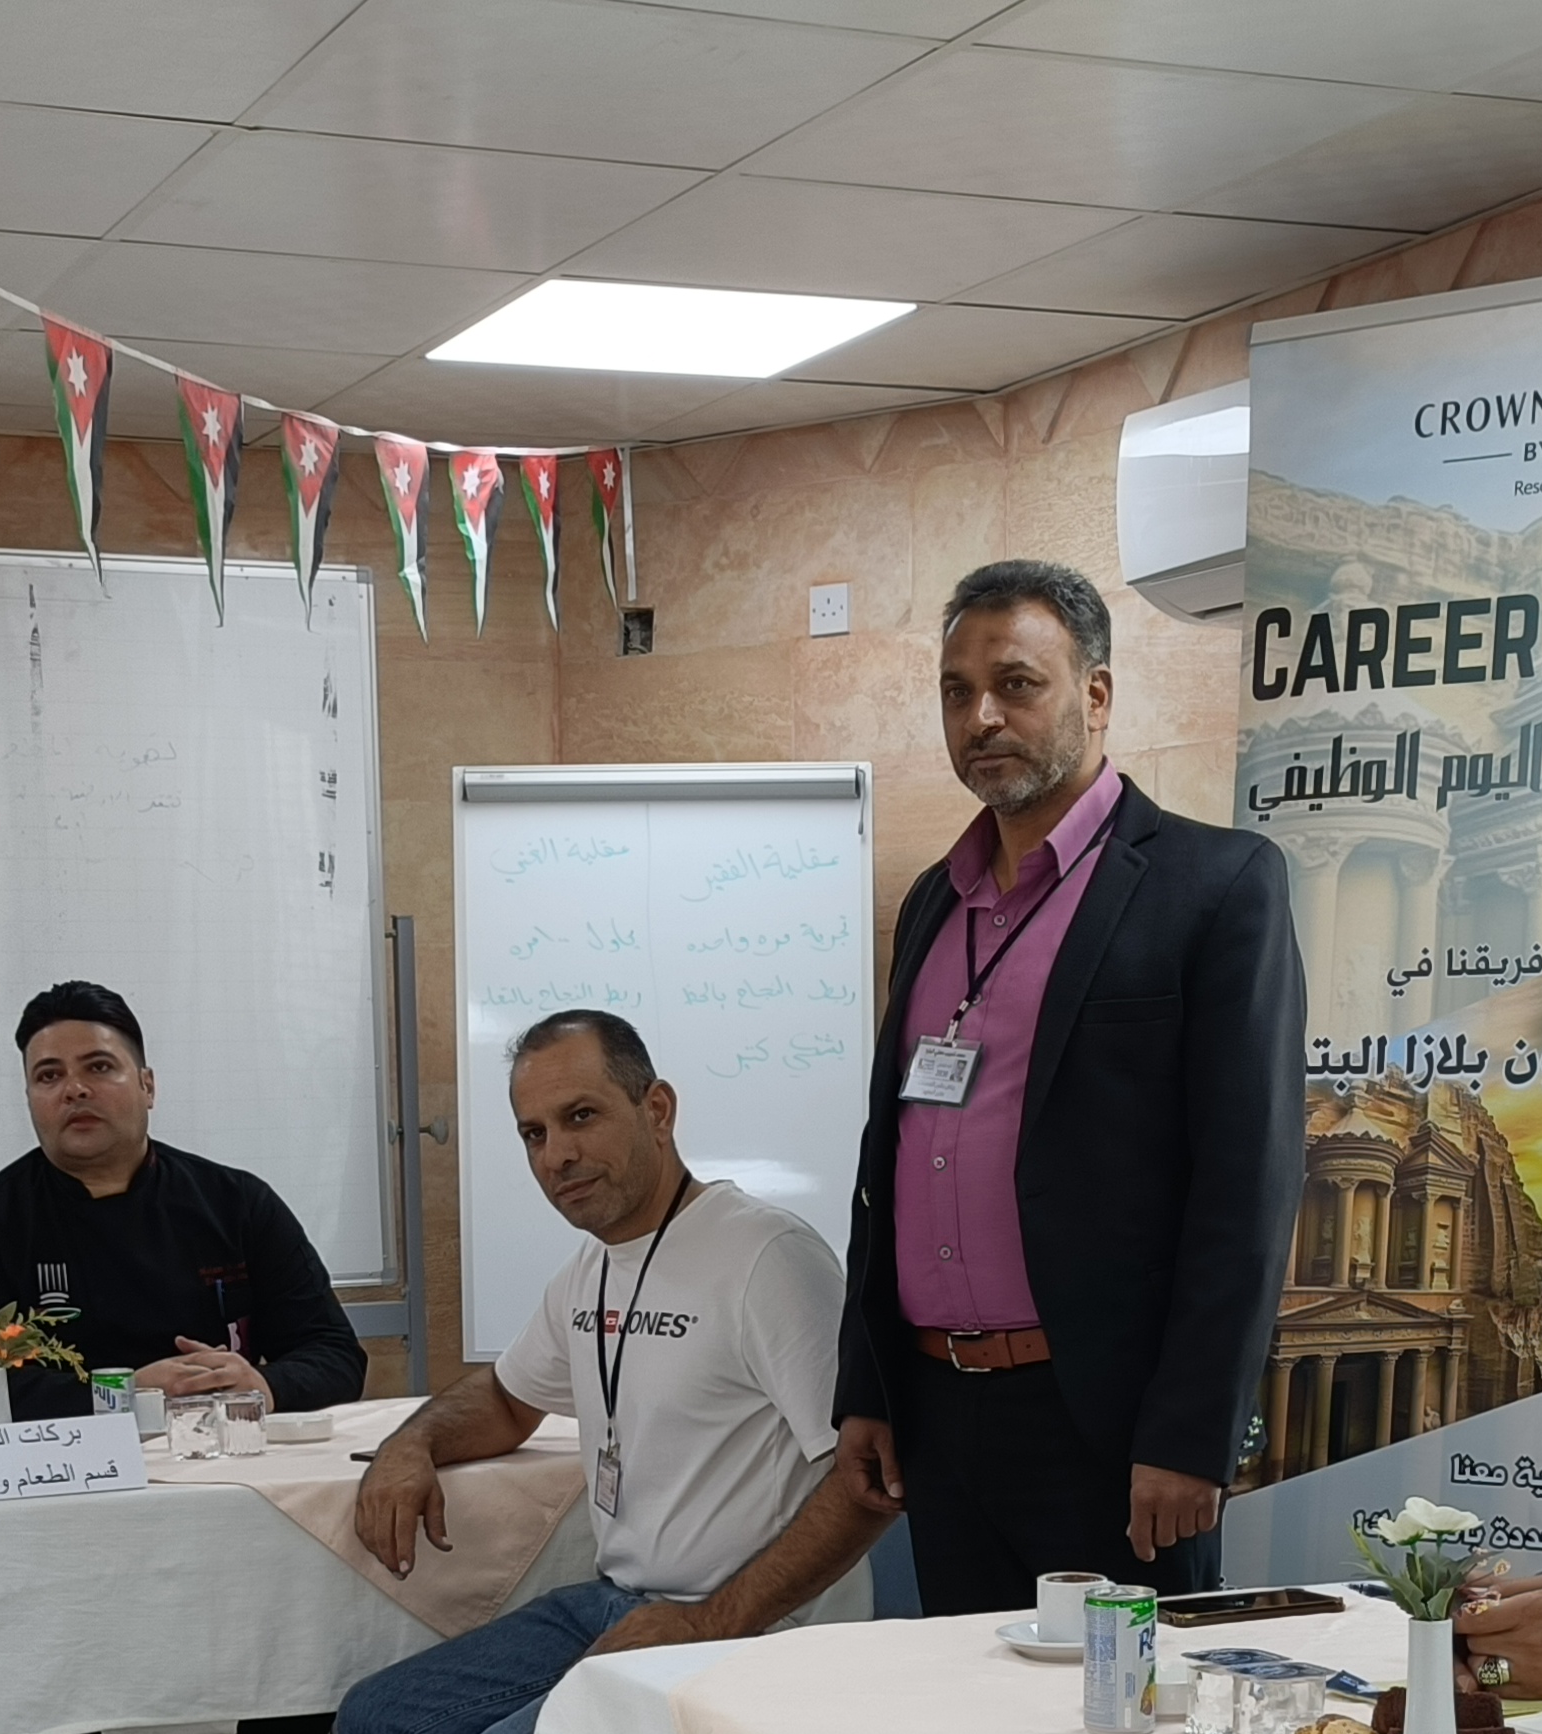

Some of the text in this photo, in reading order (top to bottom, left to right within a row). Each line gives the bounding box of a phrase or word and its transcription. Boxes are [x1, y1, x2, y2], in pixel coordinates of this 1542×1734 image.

[1252, 593, 1541, 701] CAREER
[1248, 728, 1422, 822] الوظيفي
[1386, 947, 1433, 997] في
[1405, 1033, 1489, 1093] بلازا
[18, 1423, 82, 1447] بركات
[16, 1463, 75, 1496] الطعام
[84, 1460, 120, 1489] قسم
[1450, 1453, 1508, 1487] معنا
